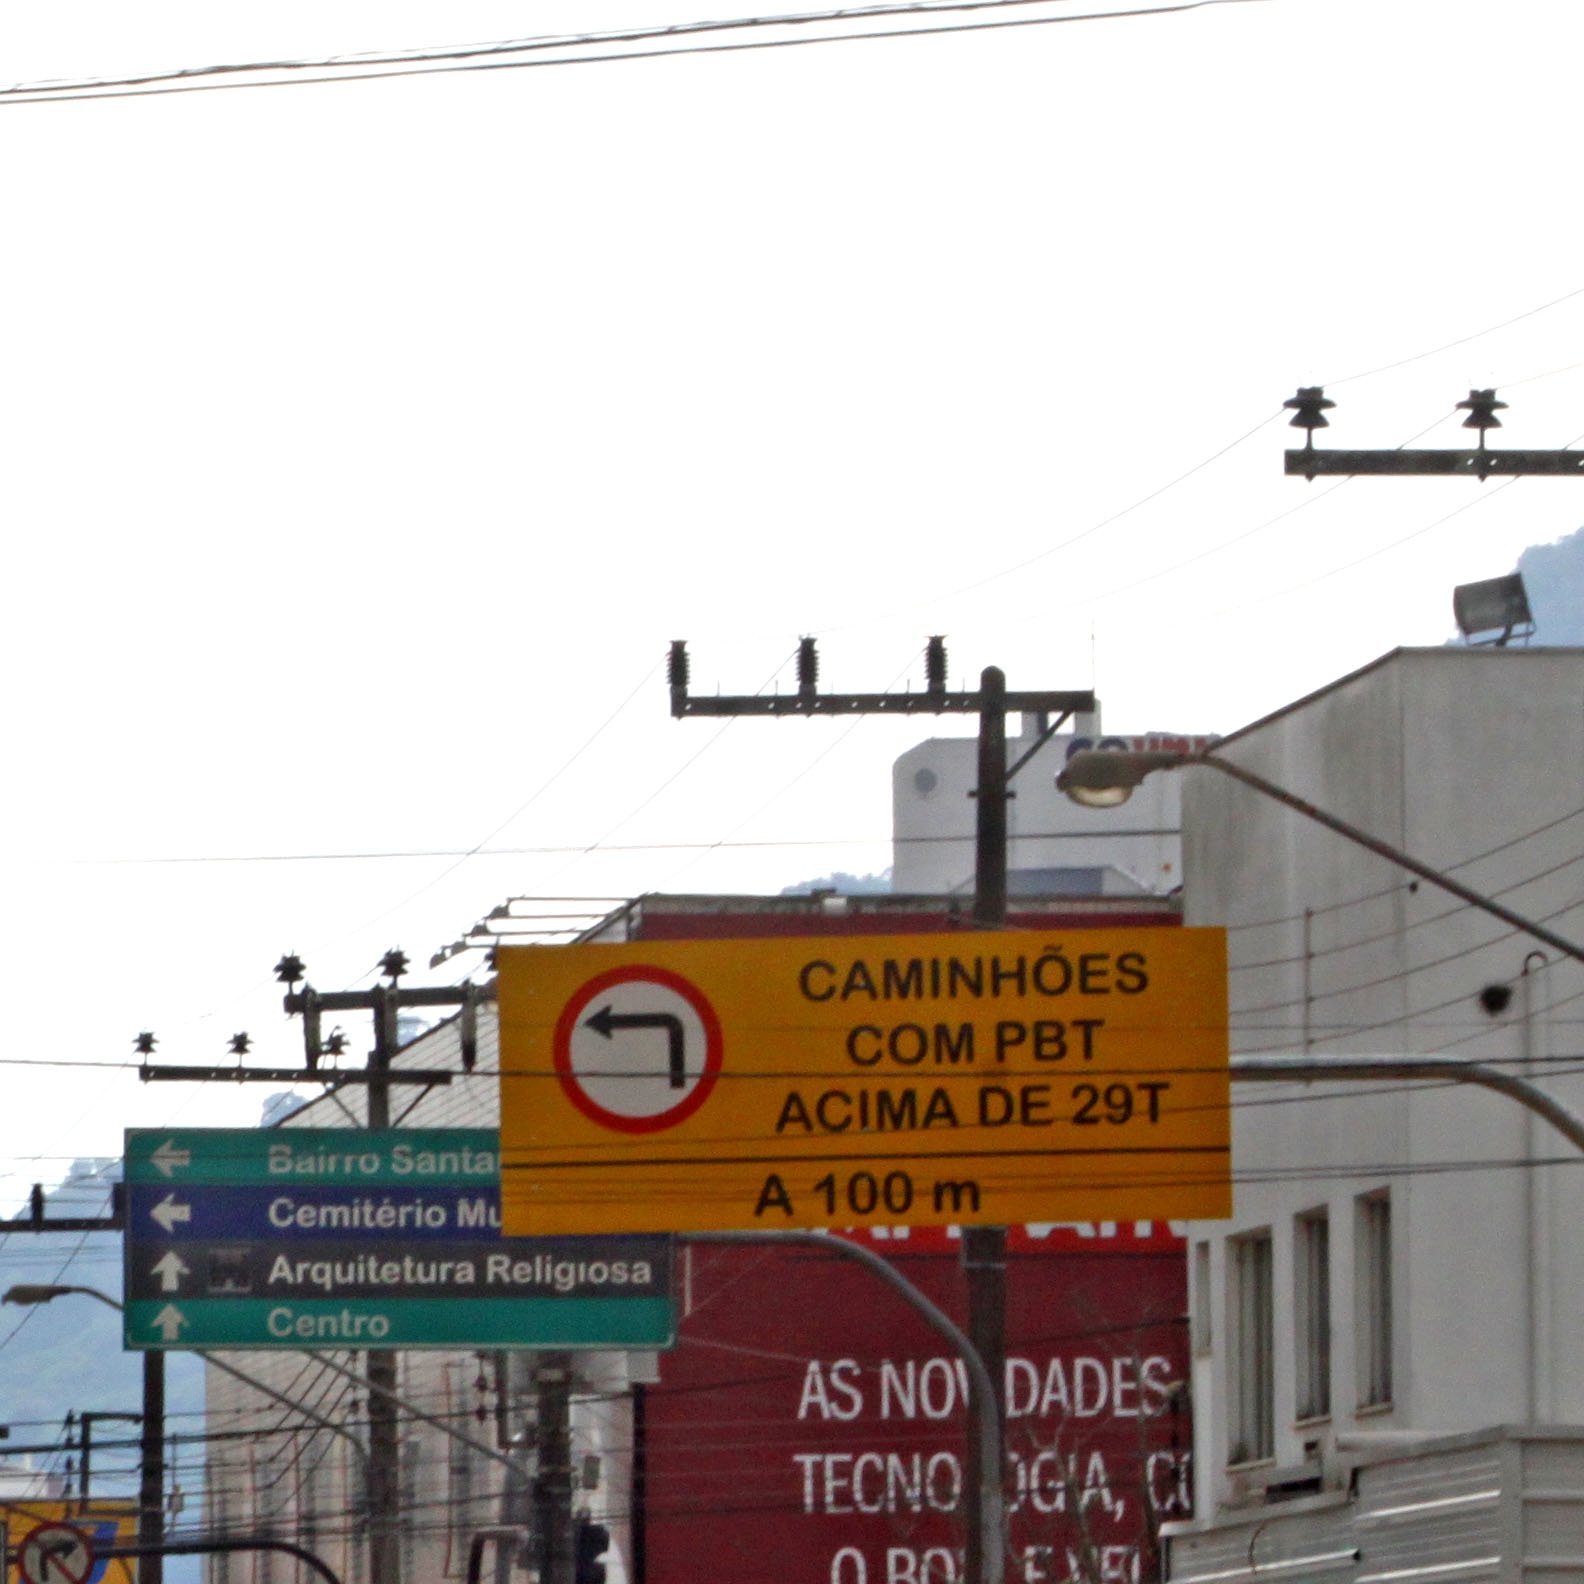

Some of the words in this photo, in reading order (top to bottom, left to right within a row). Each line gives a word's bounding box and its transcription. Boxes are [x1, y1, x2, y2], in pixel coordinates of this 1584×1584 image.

[799, 945, 1149, 1001] CAMINHÕES
[846, 1022, 975, 1066] COM
[995, 1019, 1105, 1062] PBT
[775, 1088, 959, 1133] ACIMA
[978, 1085, 1052, 1127] DE
[1071, 1082, 1170, 1125] 29T
[268, 1144, 380, 1175] Bairro
[391, 1144, 501, 1175] Santa
[268, 1198, 446, 1229] Cemitério
[458, 1199, 502, 1228] Mu
[754, 1174, 794, 1216] A
[813, 1171, 914, 1215] 100
[932, 1179, 981, 1213] m
[268, 1255, 475, 1290] Arquitetura
[486, 1255, 653, 1291] Religiosa
[268, 1307, 390, 1338] Centro
[798, 1358, 864, 1421] AS
[881, 1356, 1173, 1420] NODADES
